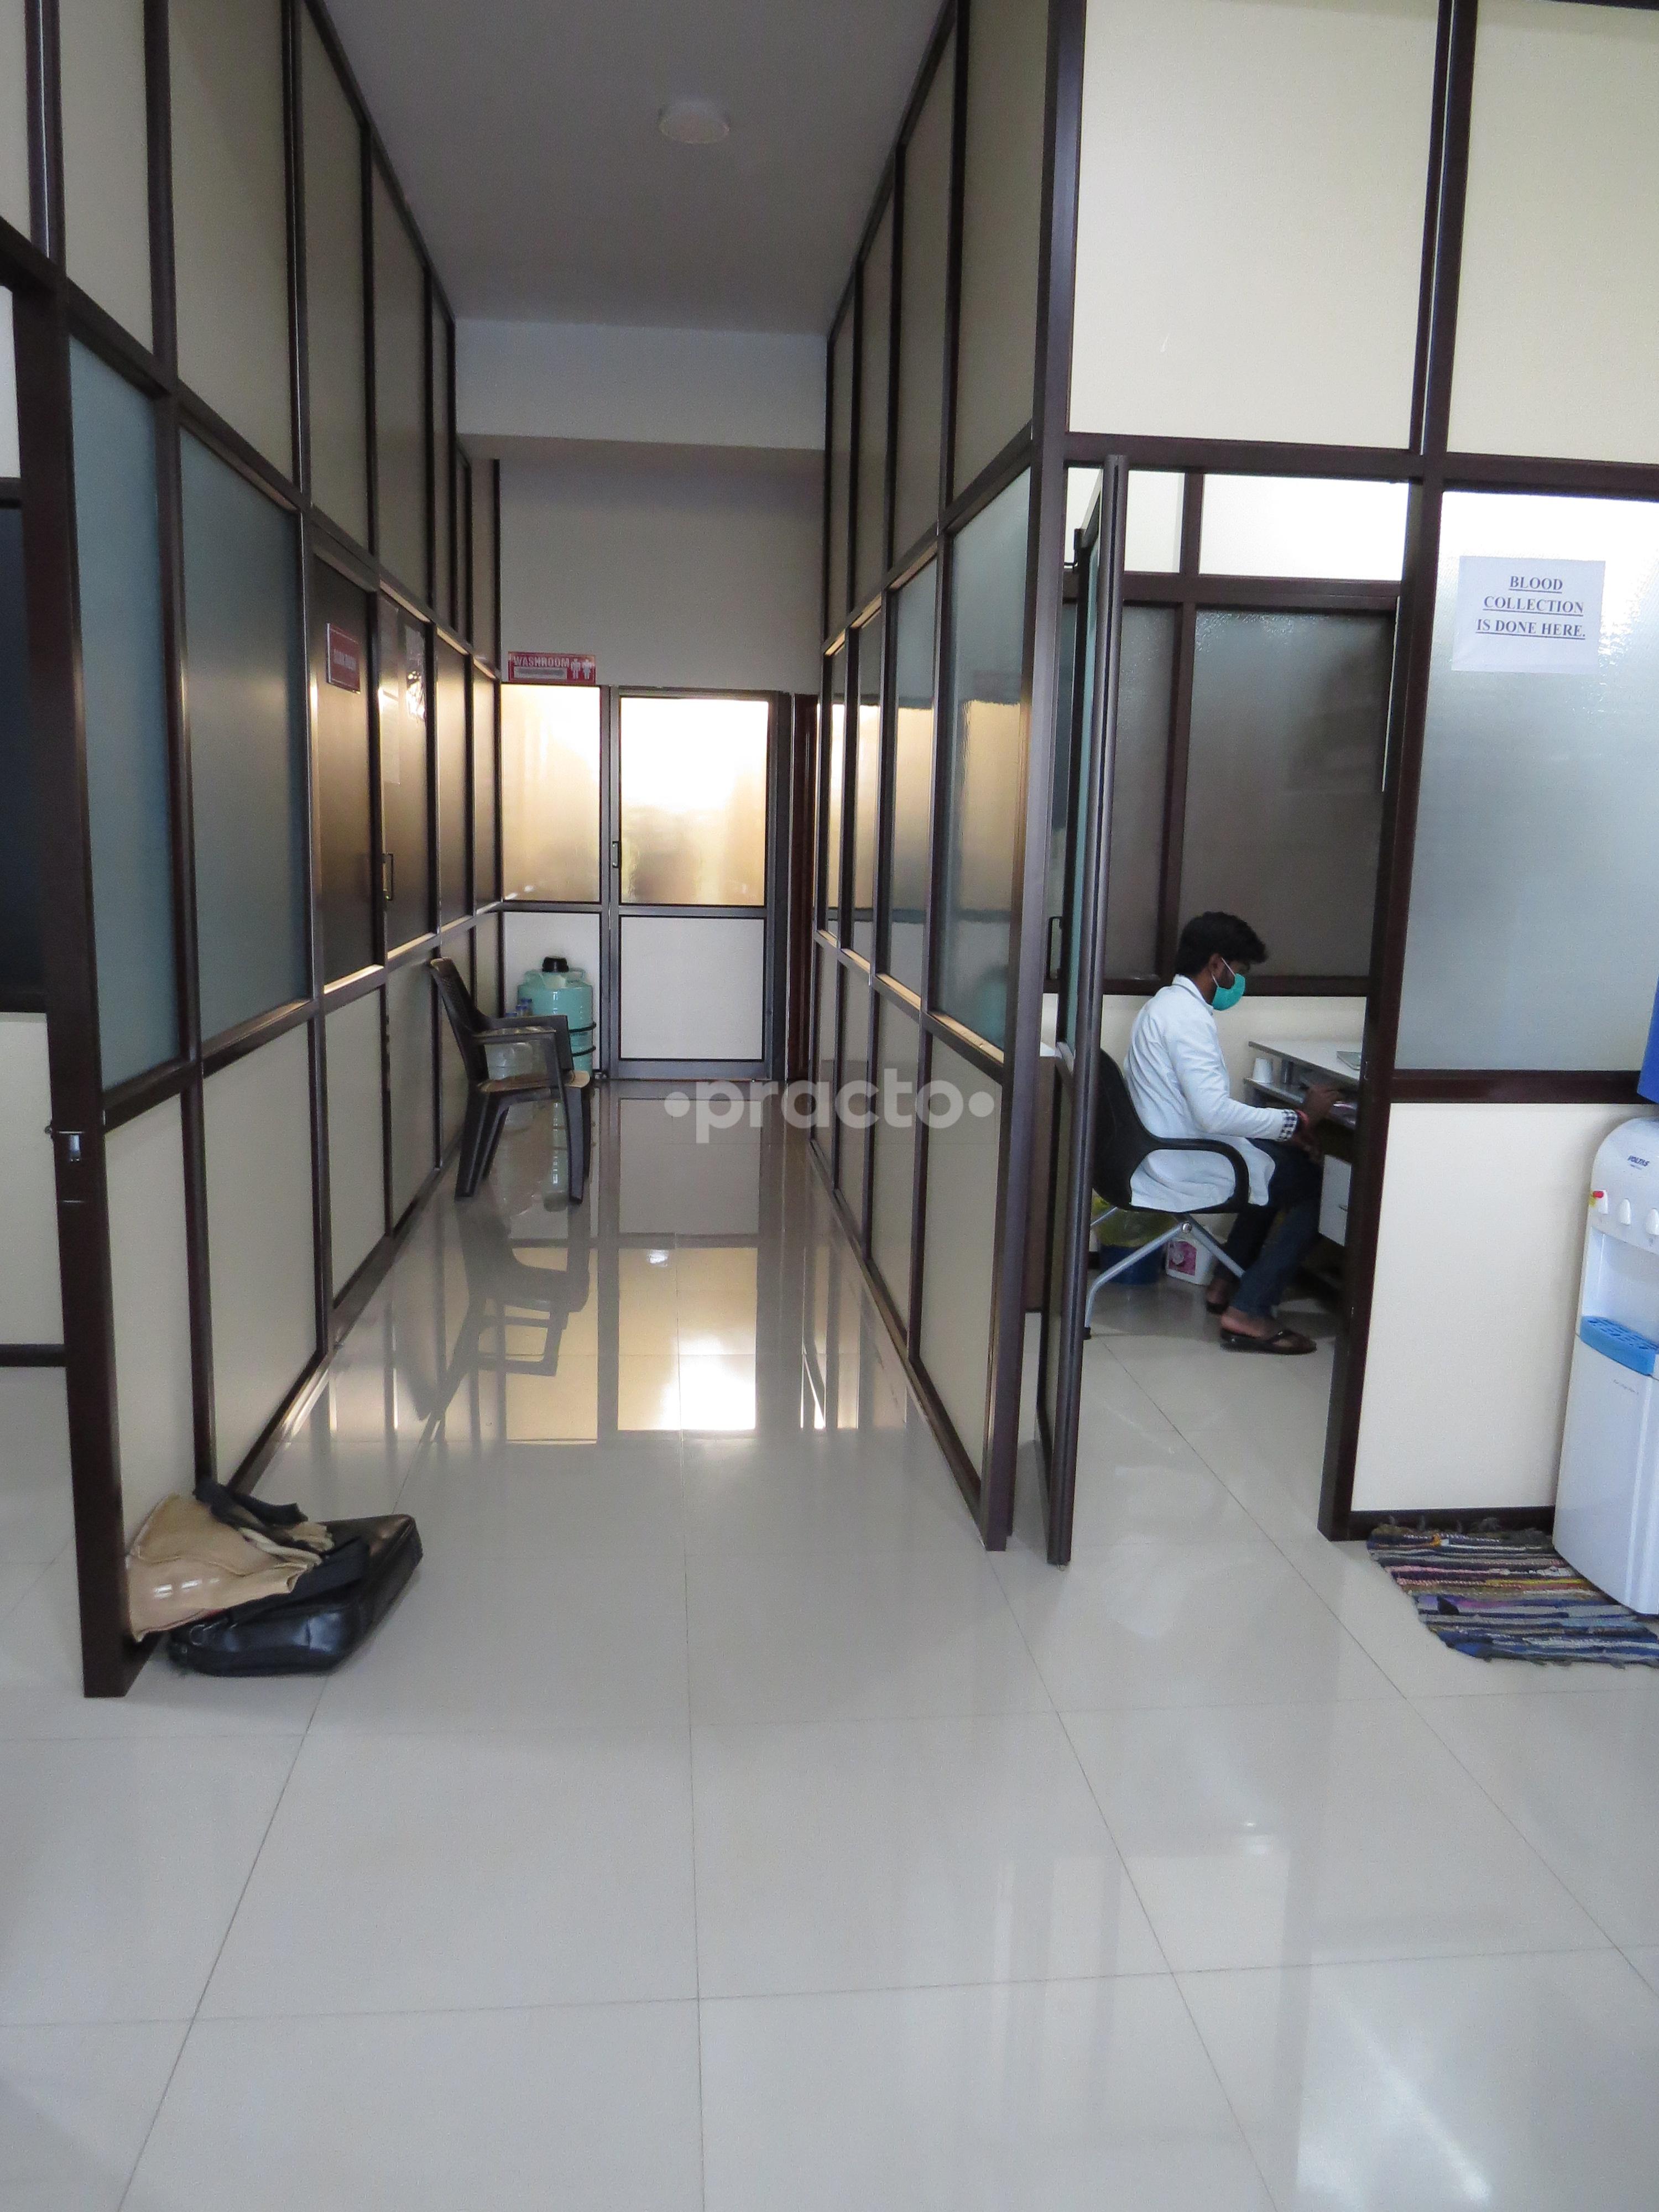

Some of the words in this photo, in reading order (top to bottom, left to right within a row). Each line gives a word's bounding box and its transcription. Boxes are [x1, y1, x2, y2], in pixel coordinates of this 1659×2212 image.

[1510, 576, 1563, 591] BLOOD
[1484, 596, 1584, 614] COLLECTION
[1477, 619, 1490, 631] IS
[1495, 619, 1536, 634] DONE
[1542, 623, 1585, 637] HERE.
[514, 656, 570, 667] WASHROOM
[1627, 1155, 1650, 1167] VOLTAS
